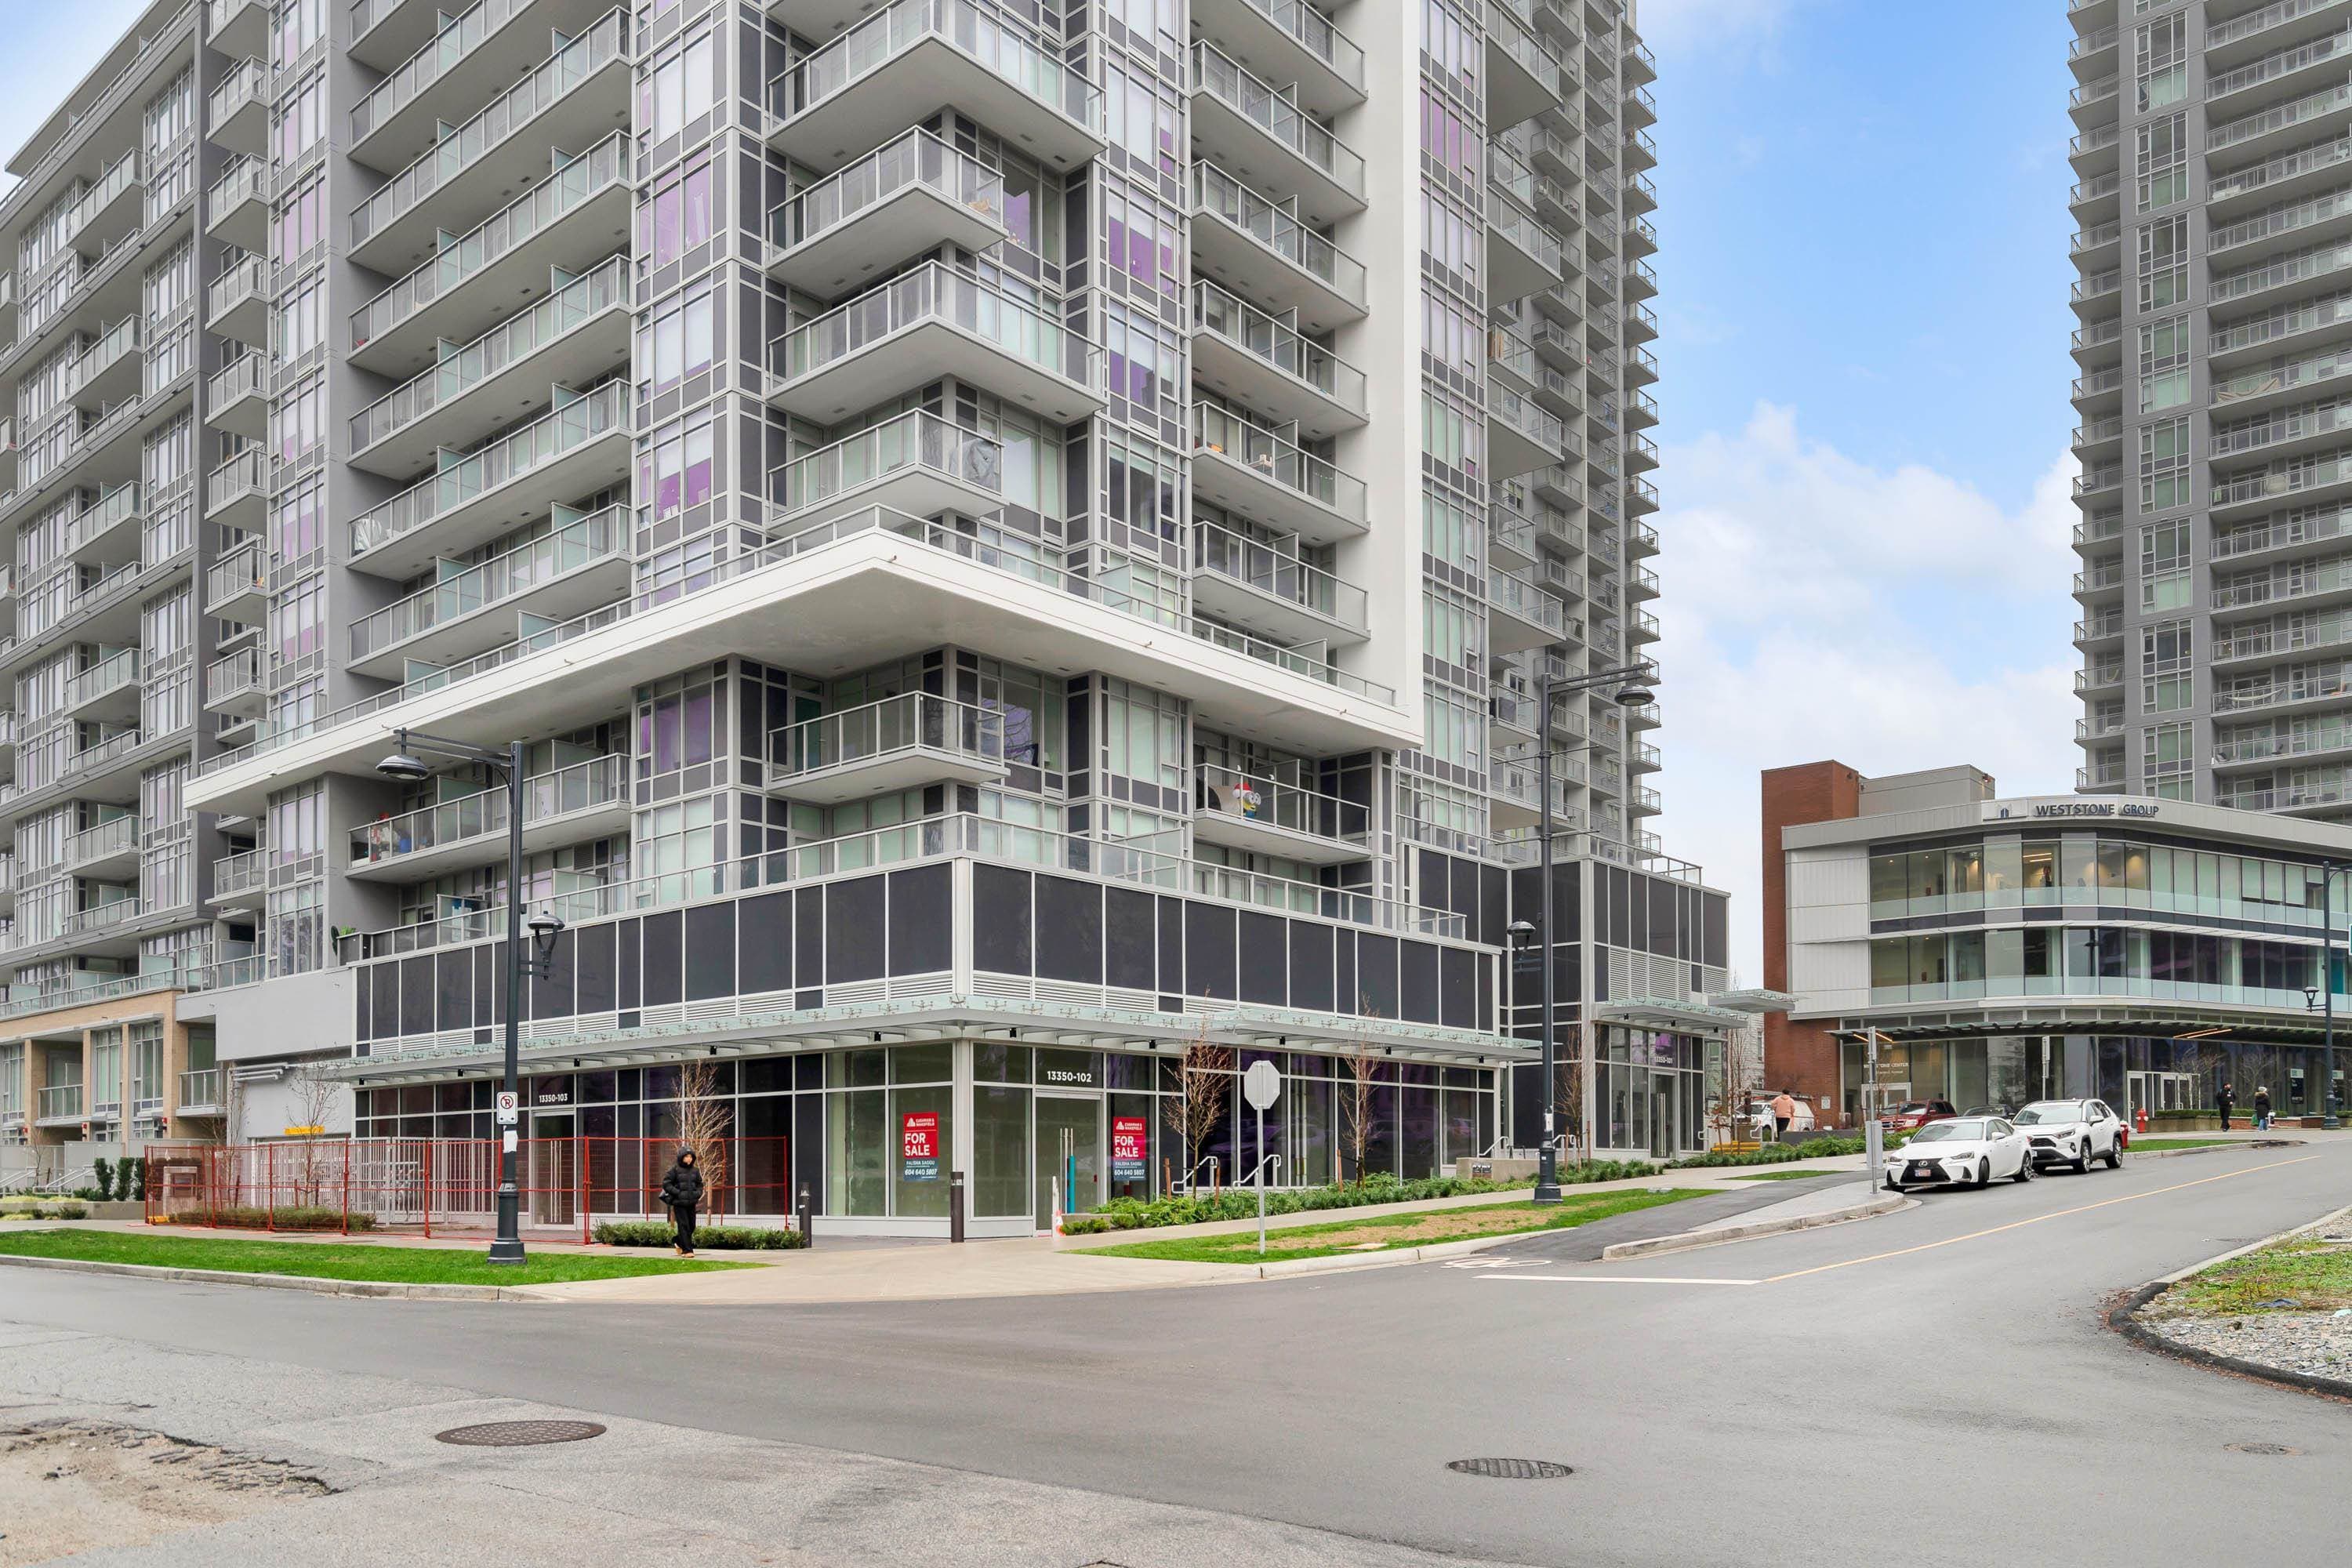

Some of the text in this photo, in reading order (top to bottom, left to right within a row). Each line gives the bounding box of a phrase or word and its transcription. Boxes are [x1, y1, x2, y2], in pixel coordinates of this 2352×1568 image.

[2036, 804, 2158, 816] WESTSTONE GROUP
[1047, 1071, 1091, 1082] 13350-102
[539, 1093, 568, 1103] 13350-103
[905, 1133, 926, 1144] FOR
[1115, 1136, 1134, 1146] FOR
[905, 1145, 930, 1156] SALE
[1115, 1147, 1138, 1157] SALE
